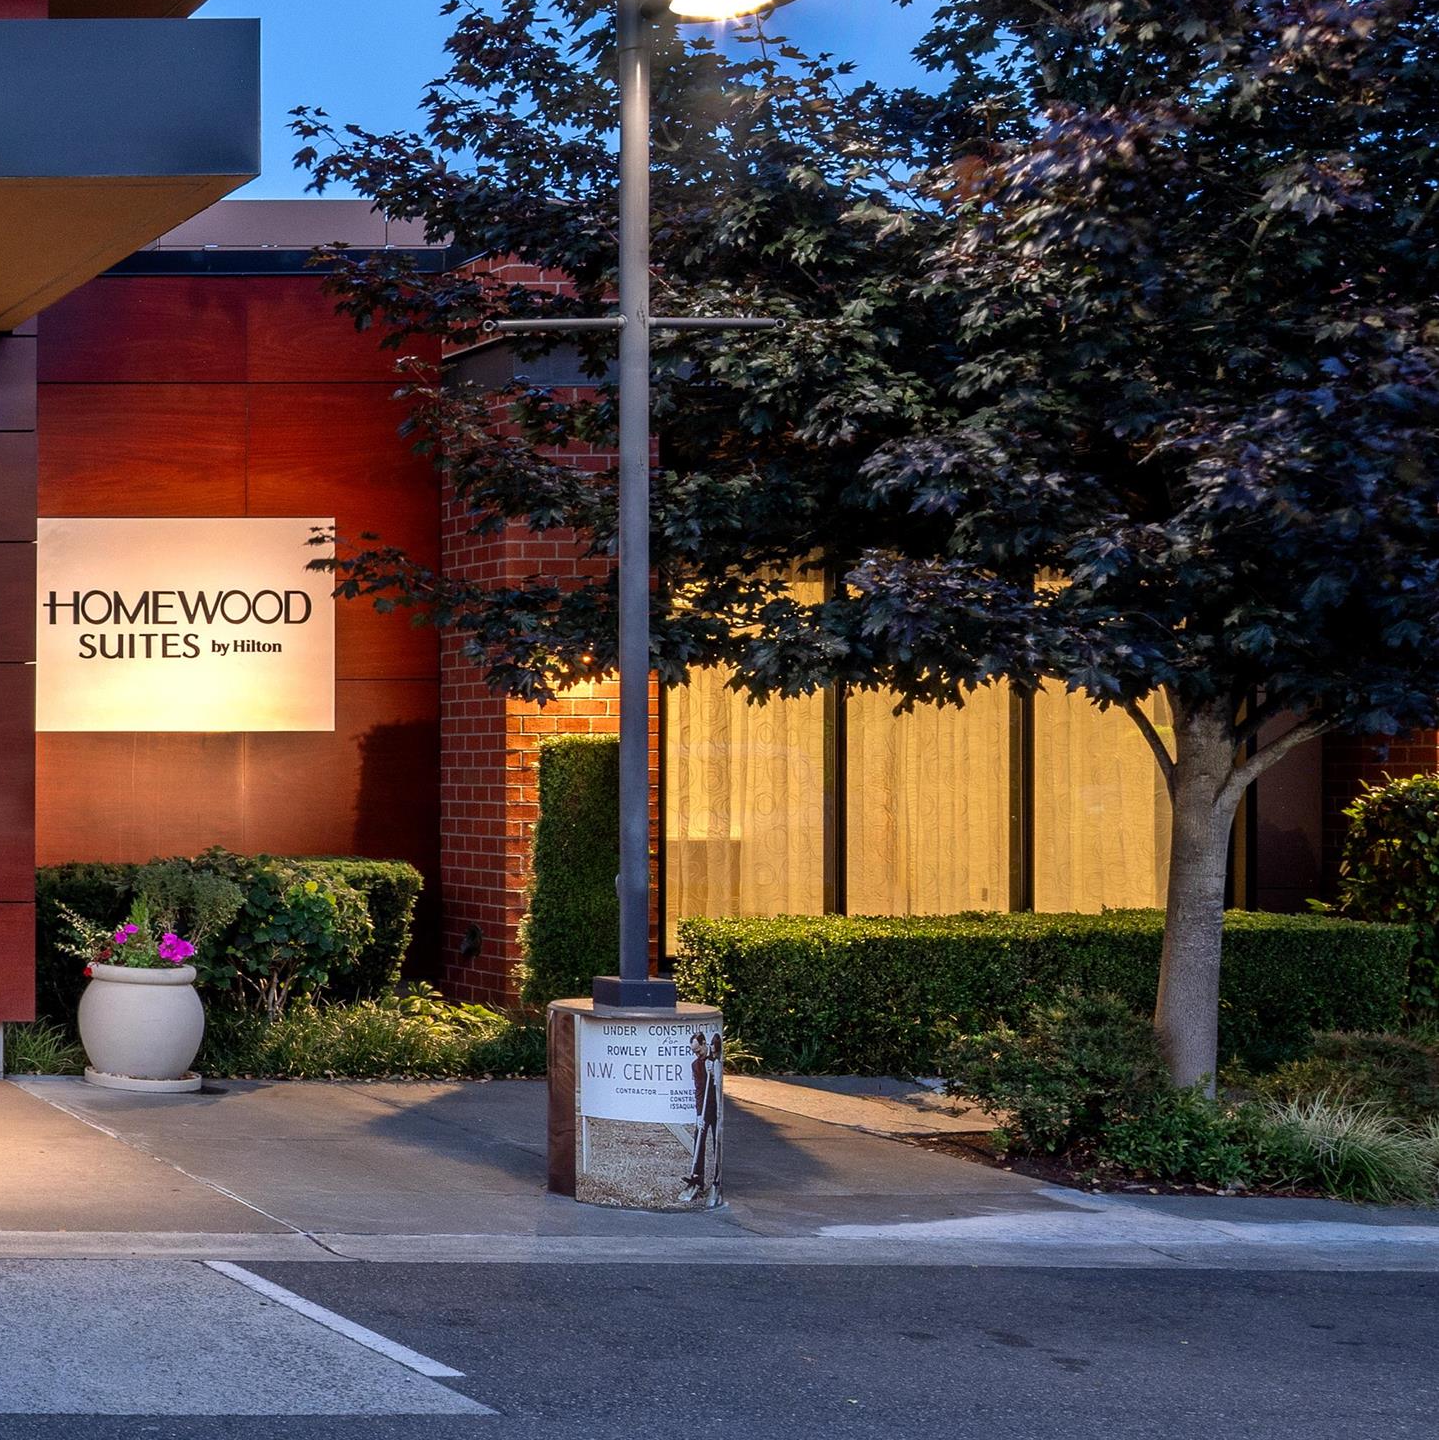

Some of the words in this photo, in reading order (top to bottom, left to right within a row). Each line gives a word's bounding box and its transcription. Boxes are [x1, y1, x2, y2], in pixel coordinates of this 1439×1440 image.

[43, 589, 312, 625] HOMEWOOD
[78, 633, 201, 659] SUITES
[211, 639, 229, 656] by
[233, 639, 283, 653] Hilton
[603, 1025, 638, 1036] UNDER
[607, 1045, 648, 1056] ROWLEY
[658, 1045, 693, 1057] ENTER
[587, 1061, 616, 1079] N.W.
[623, 1063, 683, 1081] CENTER
[615, 1087, 657, 1095] CONTRACTOR
